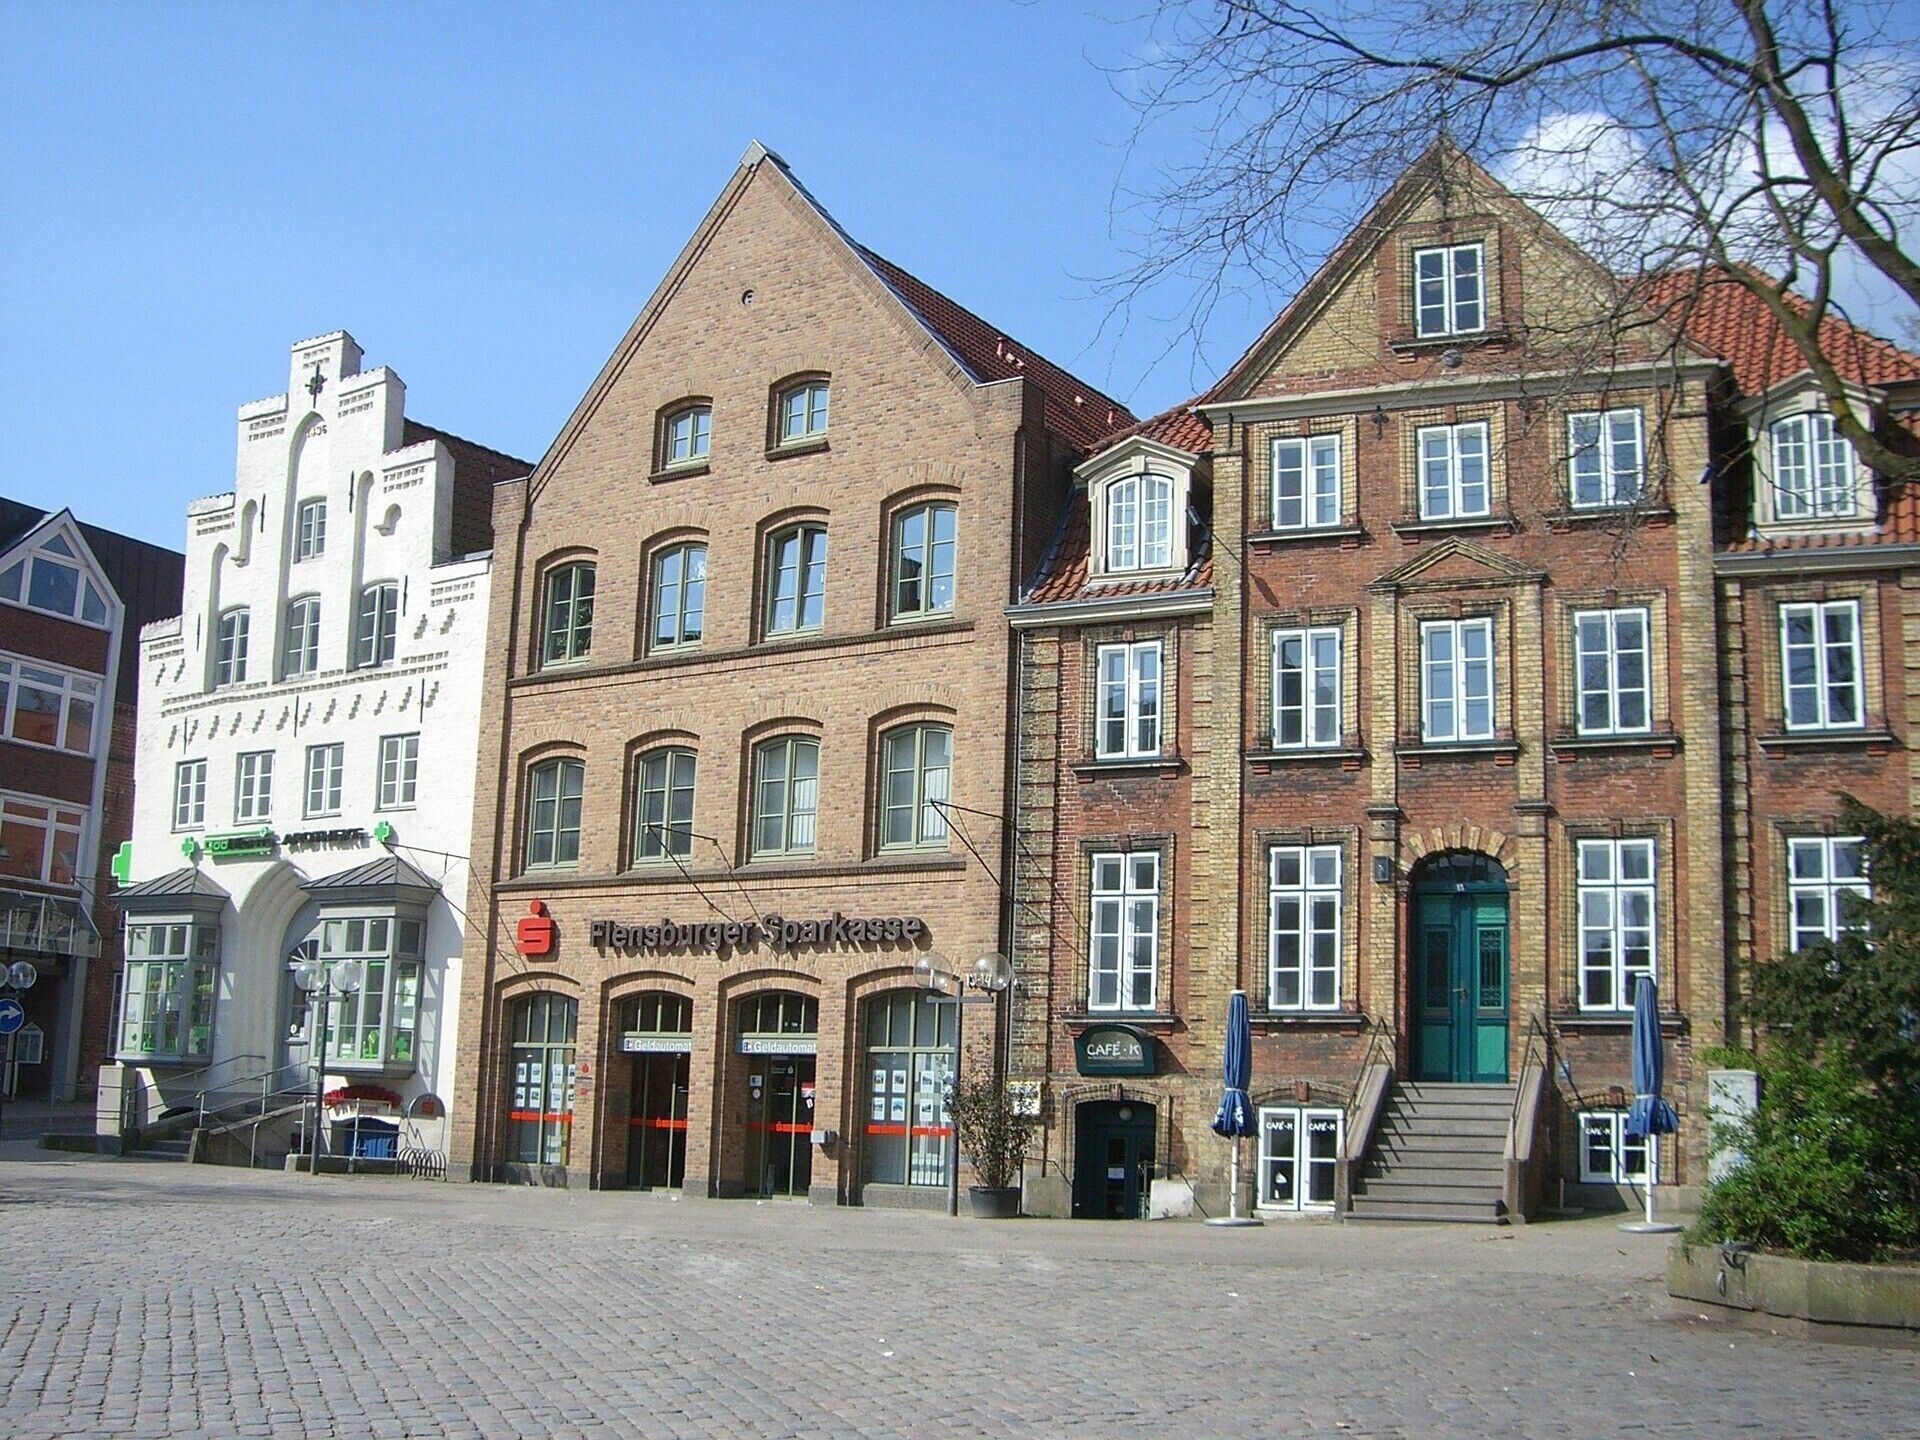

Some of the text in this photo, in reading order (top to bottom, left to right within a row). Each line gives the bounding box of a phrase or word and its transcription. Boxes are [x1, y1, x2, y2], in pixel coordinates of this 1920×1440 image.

[590, 912, 921, 950] Flensburger Sparkasse
[634, 1038, 691, 1052] Geldautomat
[753, 1039, 816, 1053] Geldautomat
